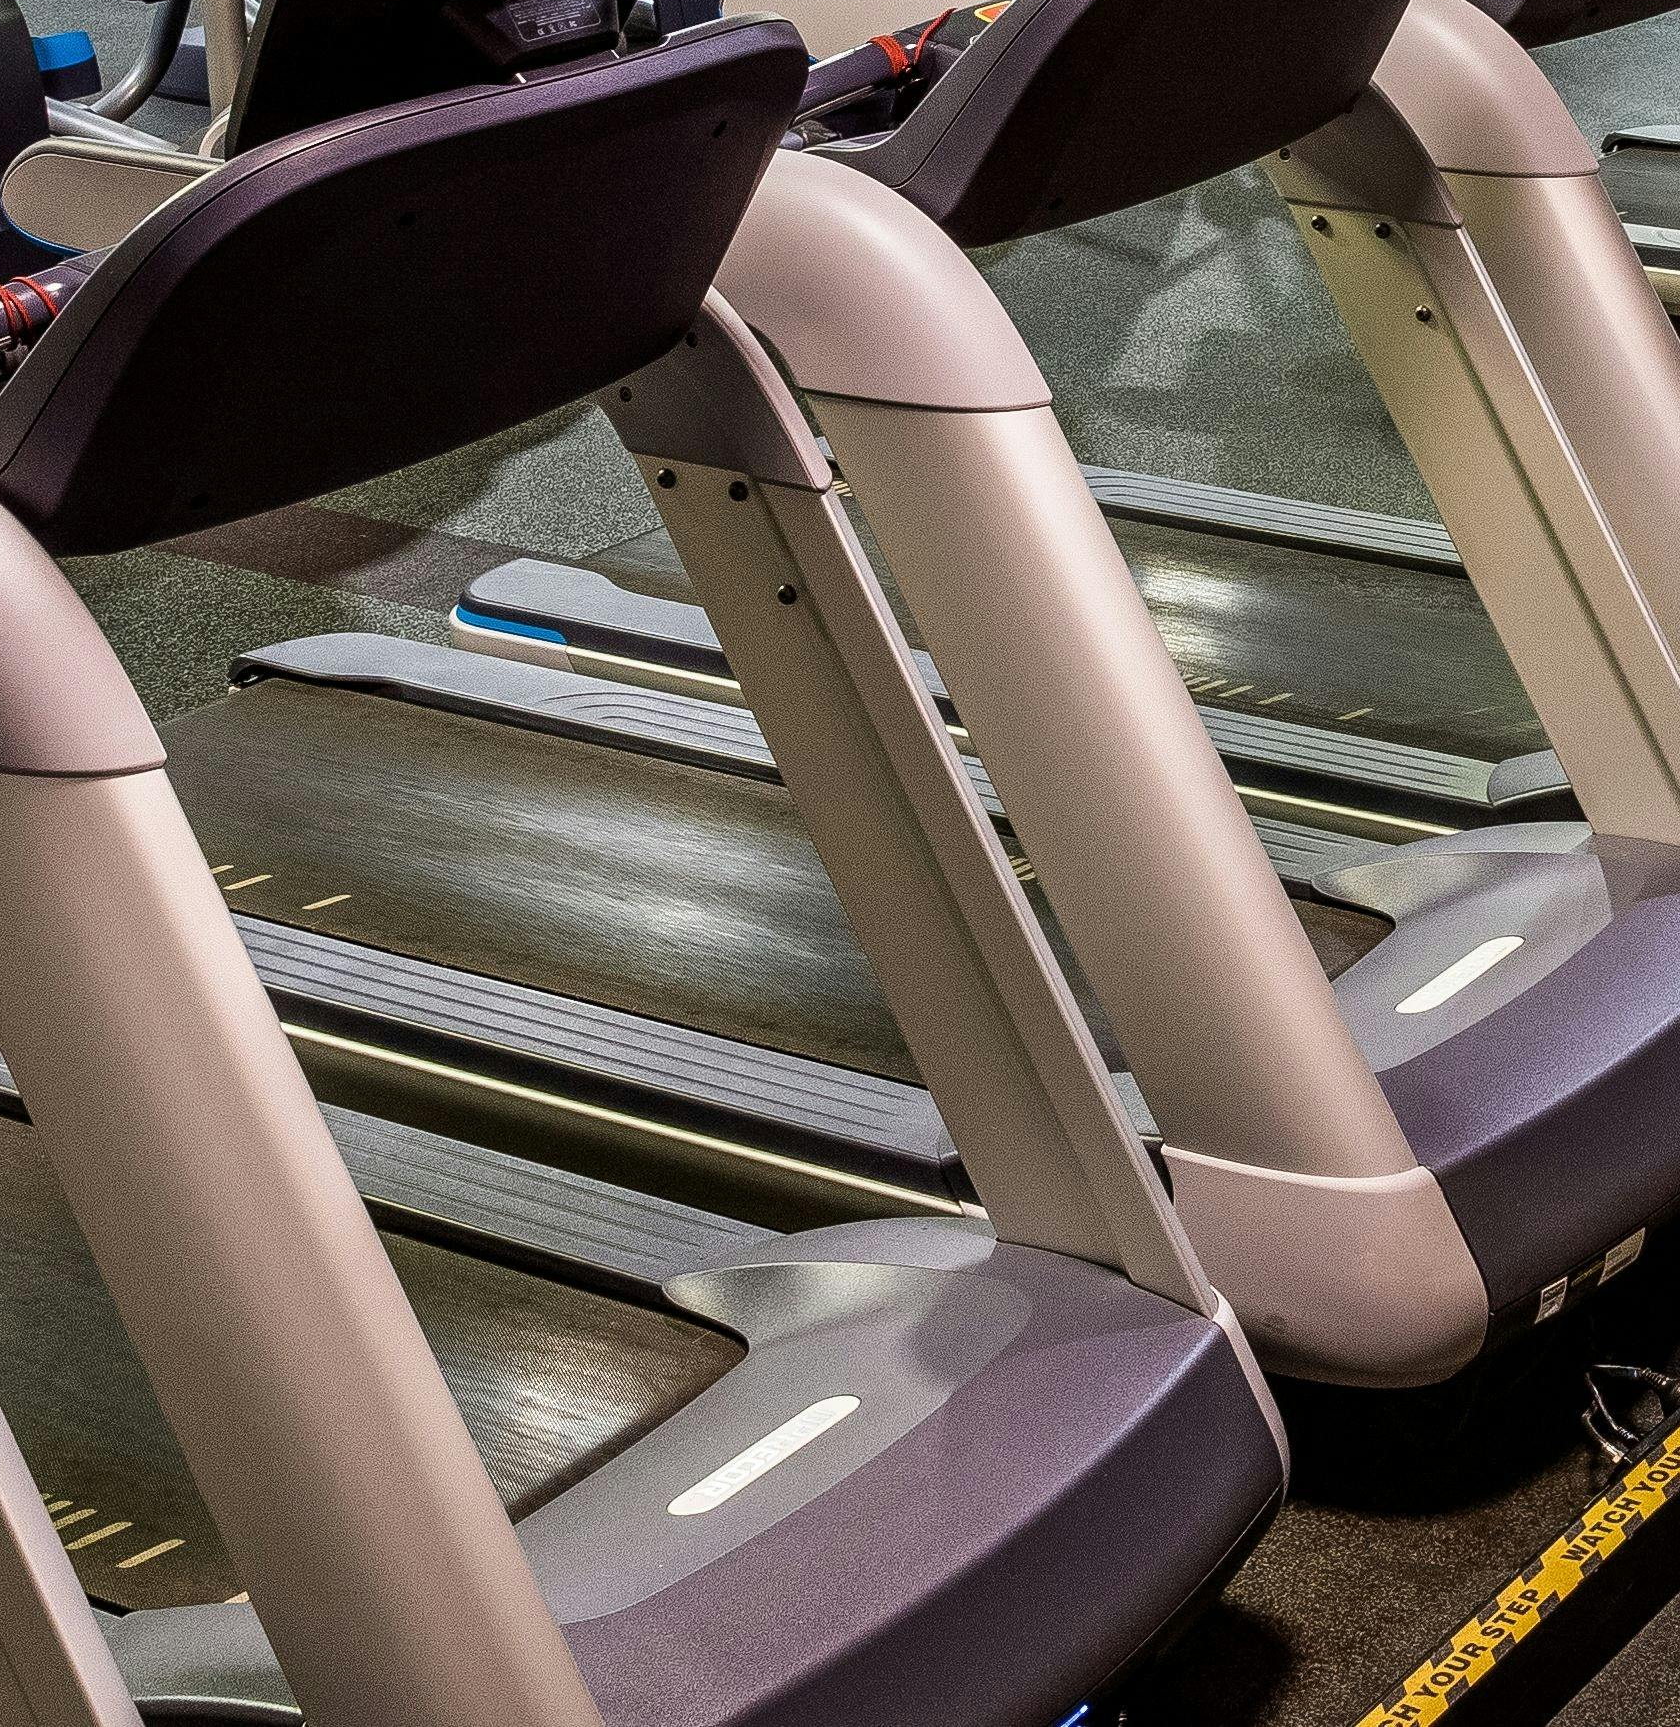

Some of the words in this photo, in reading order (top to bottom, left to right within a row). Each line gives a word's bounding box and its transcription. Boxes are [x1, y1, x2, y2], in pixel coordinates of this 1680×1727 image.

[1559, 1496, 1642, 1564] WATCH
[1423, 1642, 1487, 1700] YOUR
[1480, 1588, 1542, 1640] STEP
